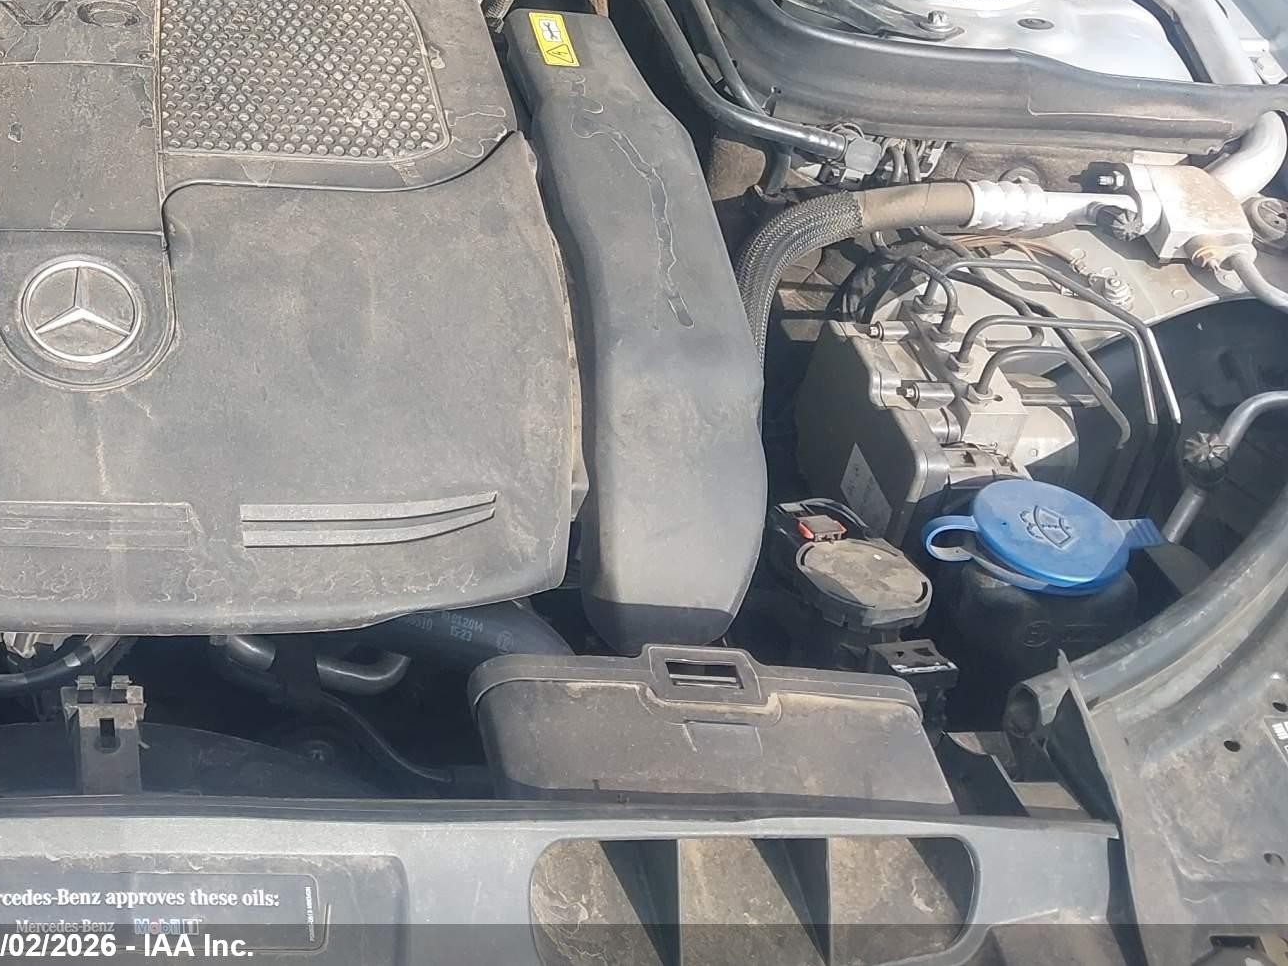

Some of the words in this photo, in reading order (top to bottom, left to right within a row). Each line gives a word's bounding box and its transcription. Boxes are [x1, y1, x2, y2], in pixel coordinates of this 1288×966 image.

[105, 891, 185, 909] approves
[190, 889, 238, 906] these
[242, 890, 280, 907] oils:
[15, 919, 116, 934] Mercedes-Benz
[134, 919, 180, 935] Mobil
